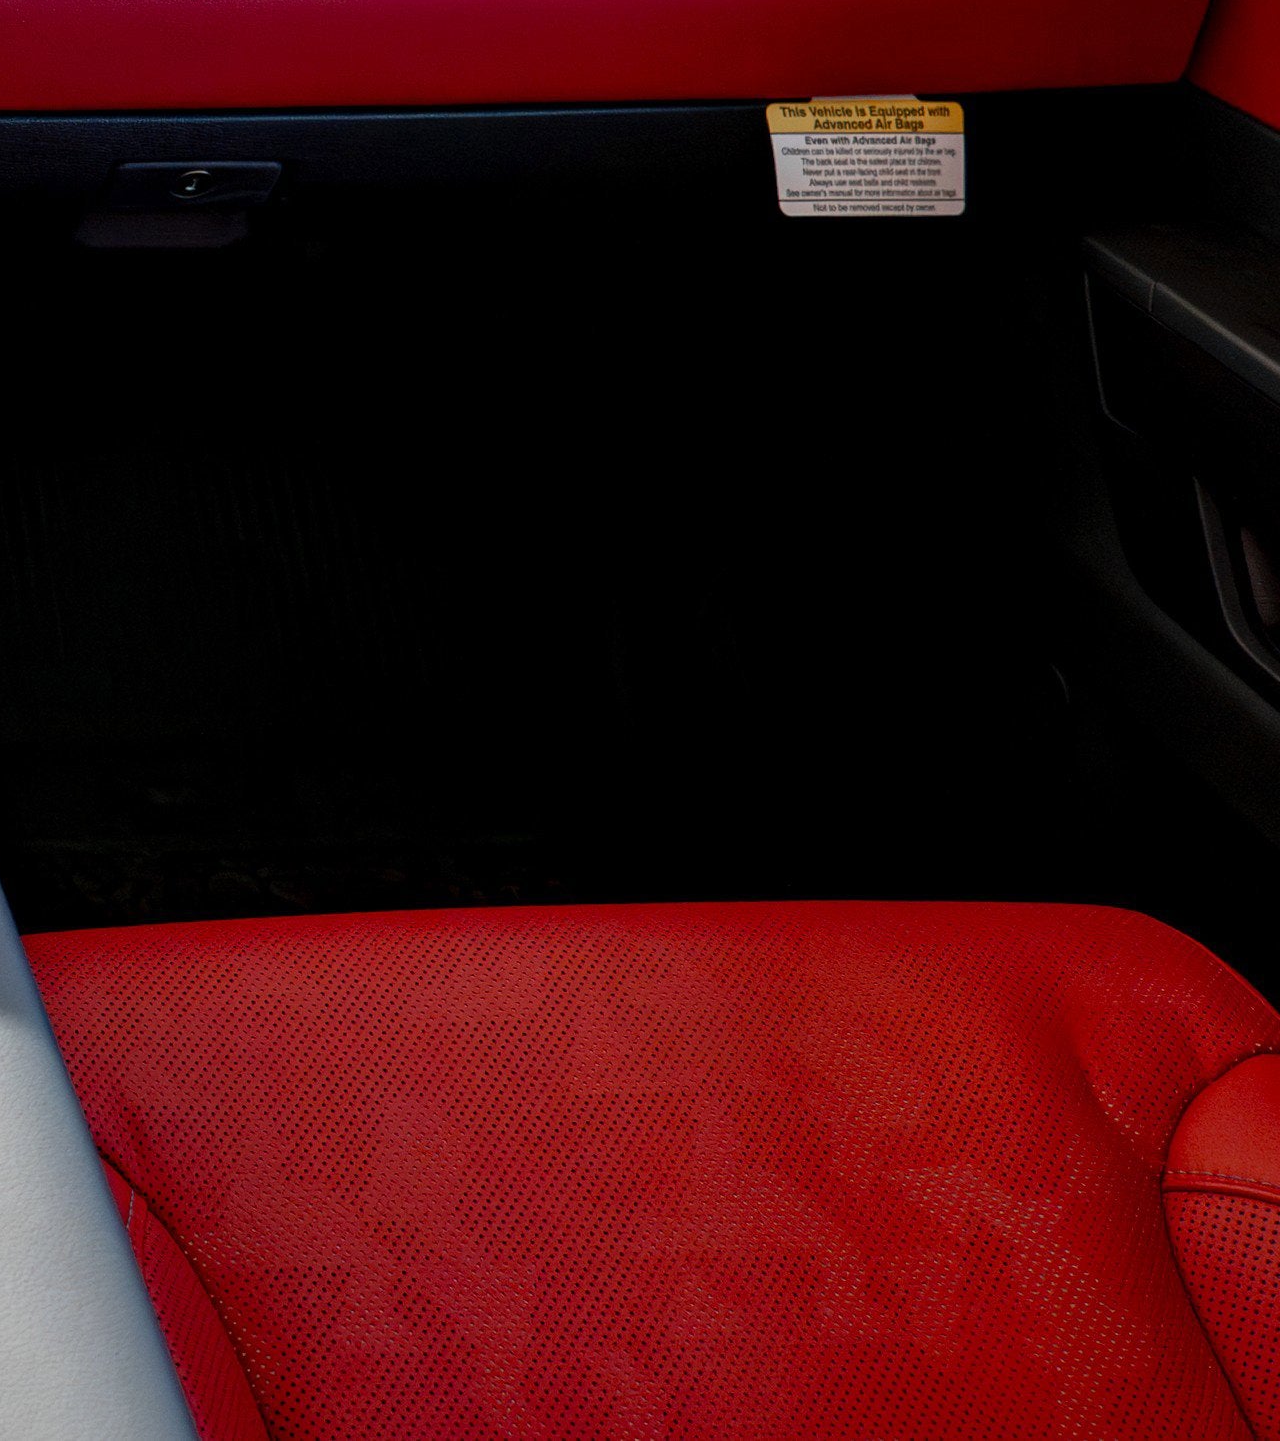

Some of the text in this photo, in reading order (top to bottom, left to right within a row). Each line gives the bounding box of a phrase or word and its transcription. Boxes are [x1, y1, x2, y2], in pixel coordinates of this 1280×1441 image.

[780, 106, 807, 118] This
[808, 106, 853, 117] Vehicle
[869, 105, 925, 119] Equipped
[927, 106, 950, 117] with
[813, 118, 924, 132] Advanced Air Bags
[805, 136, 936, 147] Even with Advanced Air Bags
